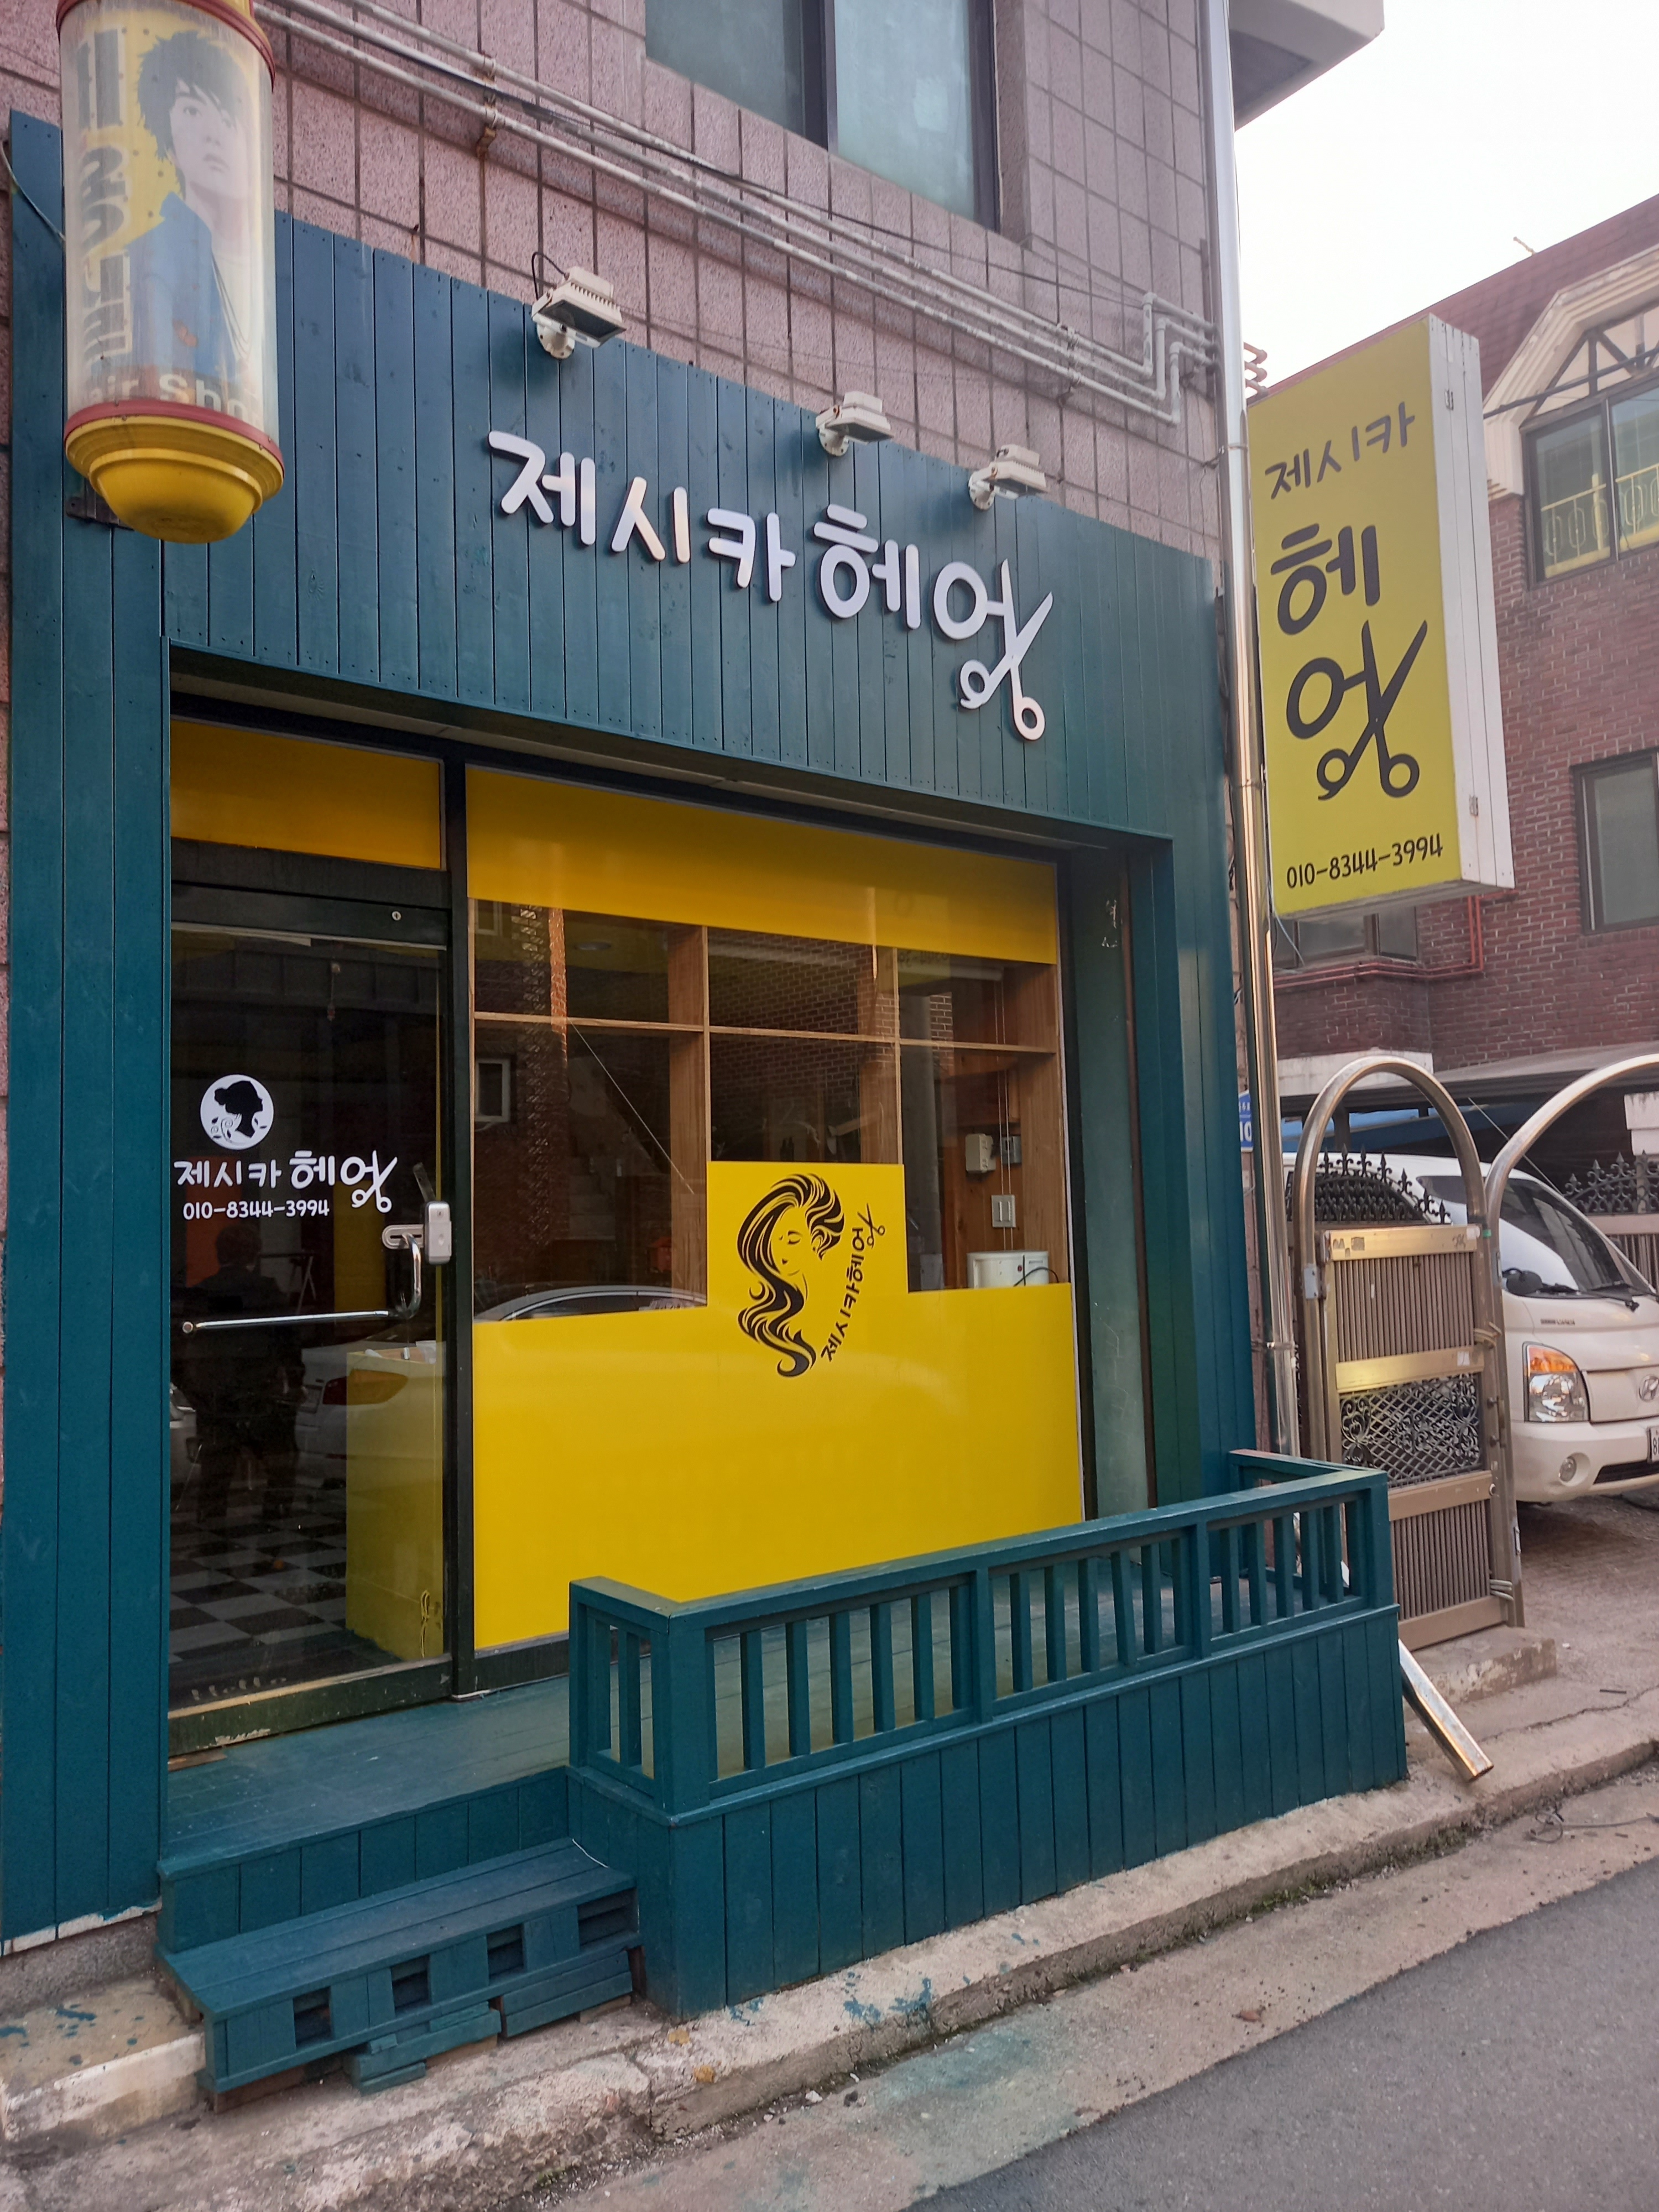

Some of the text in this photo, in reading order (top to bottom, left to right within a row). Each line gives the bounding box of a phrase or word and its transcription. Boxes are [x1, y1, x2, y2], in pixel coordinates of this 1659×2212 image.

[1265, 401, 1416, 500] 제시카
[1286, 833, 1444, 889] 010-8344-3994
[183, 1199, 330, 1220] 010-8344-3994
